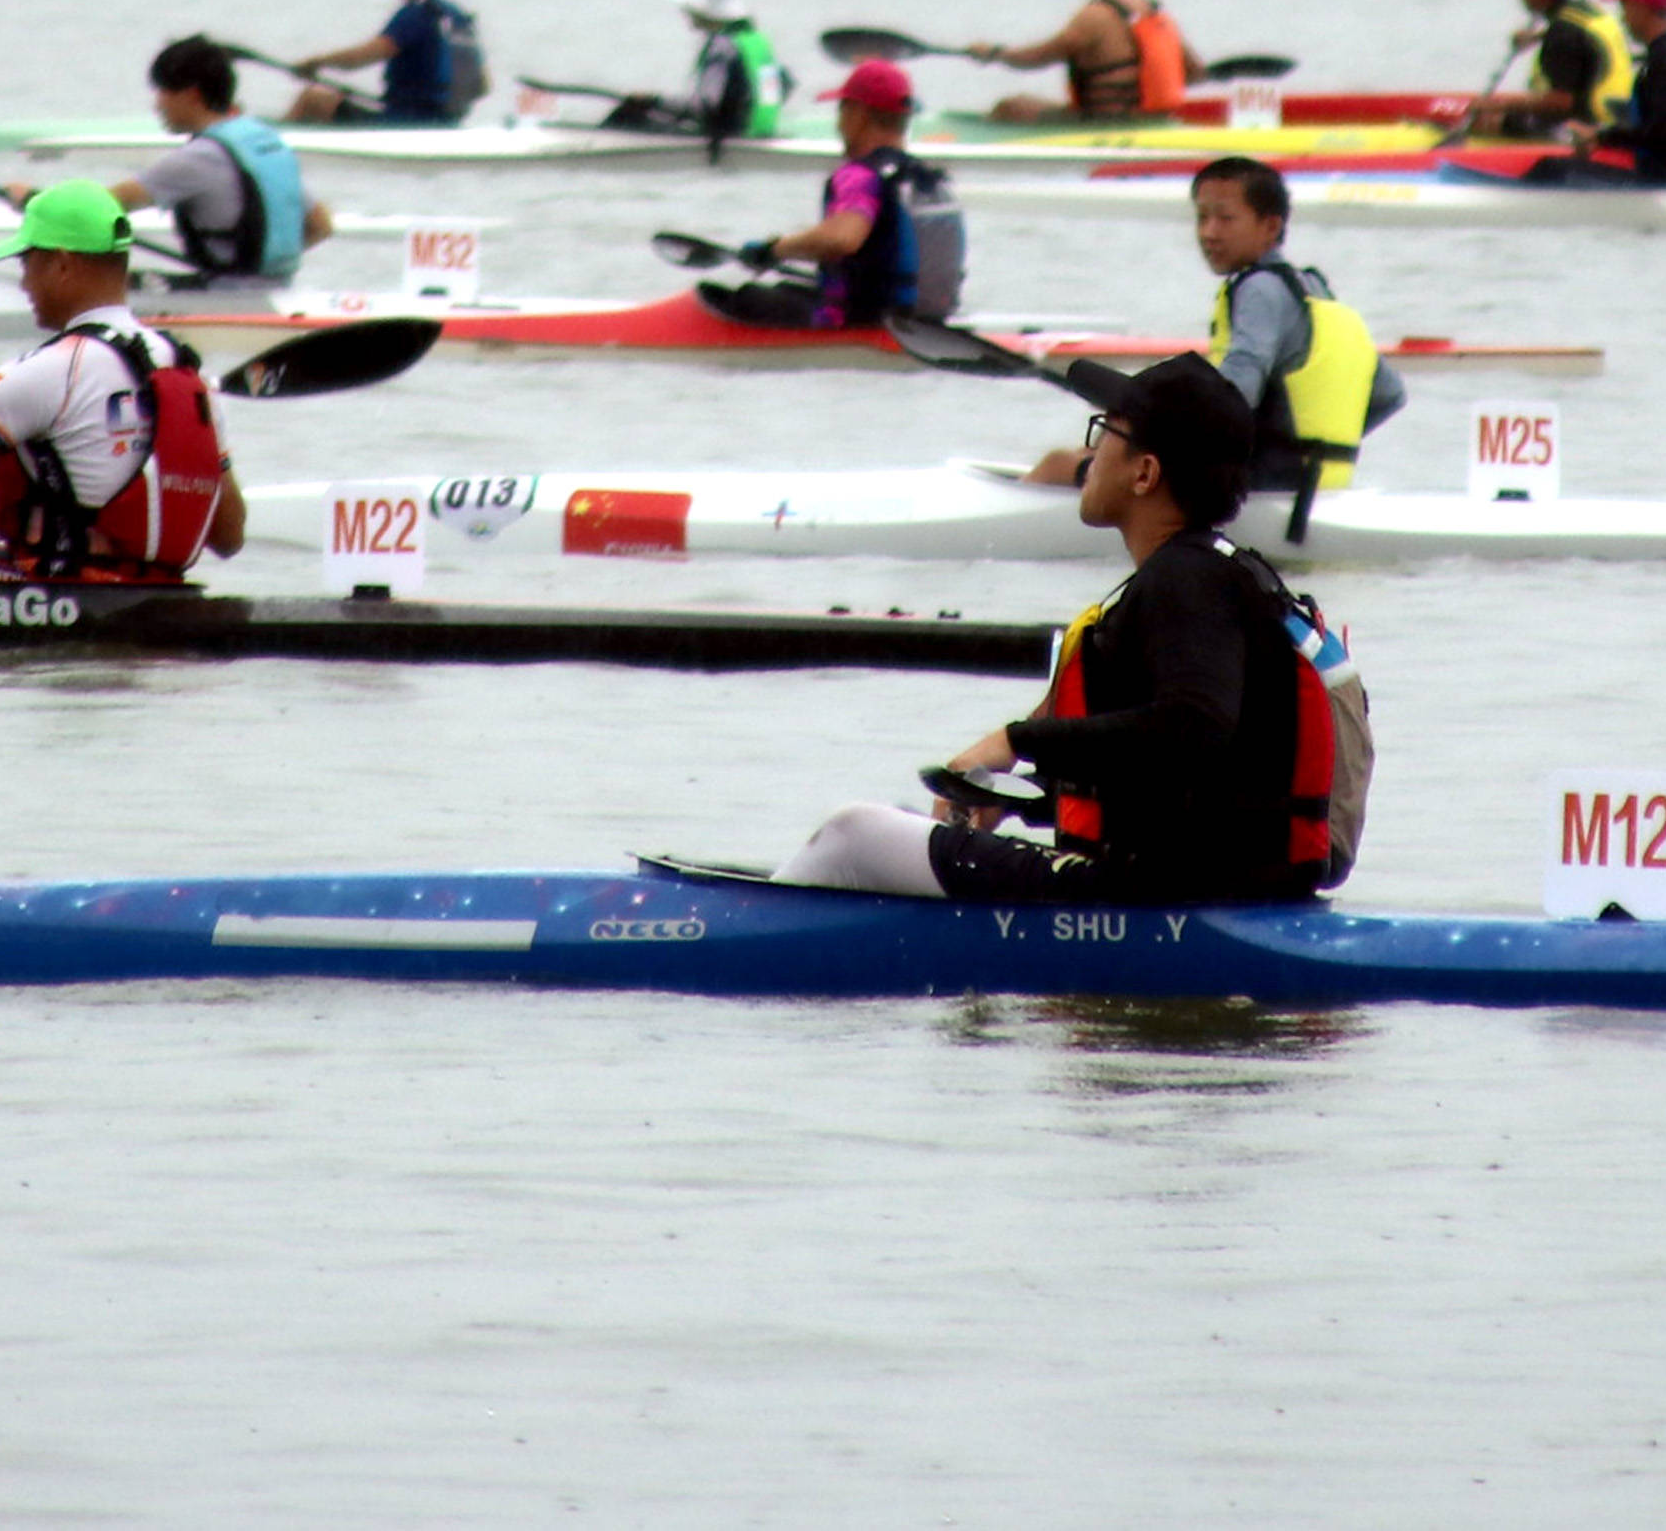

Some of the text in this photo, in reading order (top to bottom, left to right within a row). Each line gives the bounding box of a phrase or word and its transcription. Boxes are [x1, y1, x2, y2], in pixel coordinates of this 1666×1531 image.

[411, 231, 476, 270] M32
[1478, 416, 1553, 466] M25
[333, 498, 418, 554] M22
[591, 920, 705, 941] NELO
[993, 910, 1026, 939] Y.
[1052, 912, 1127, 942] SHU
